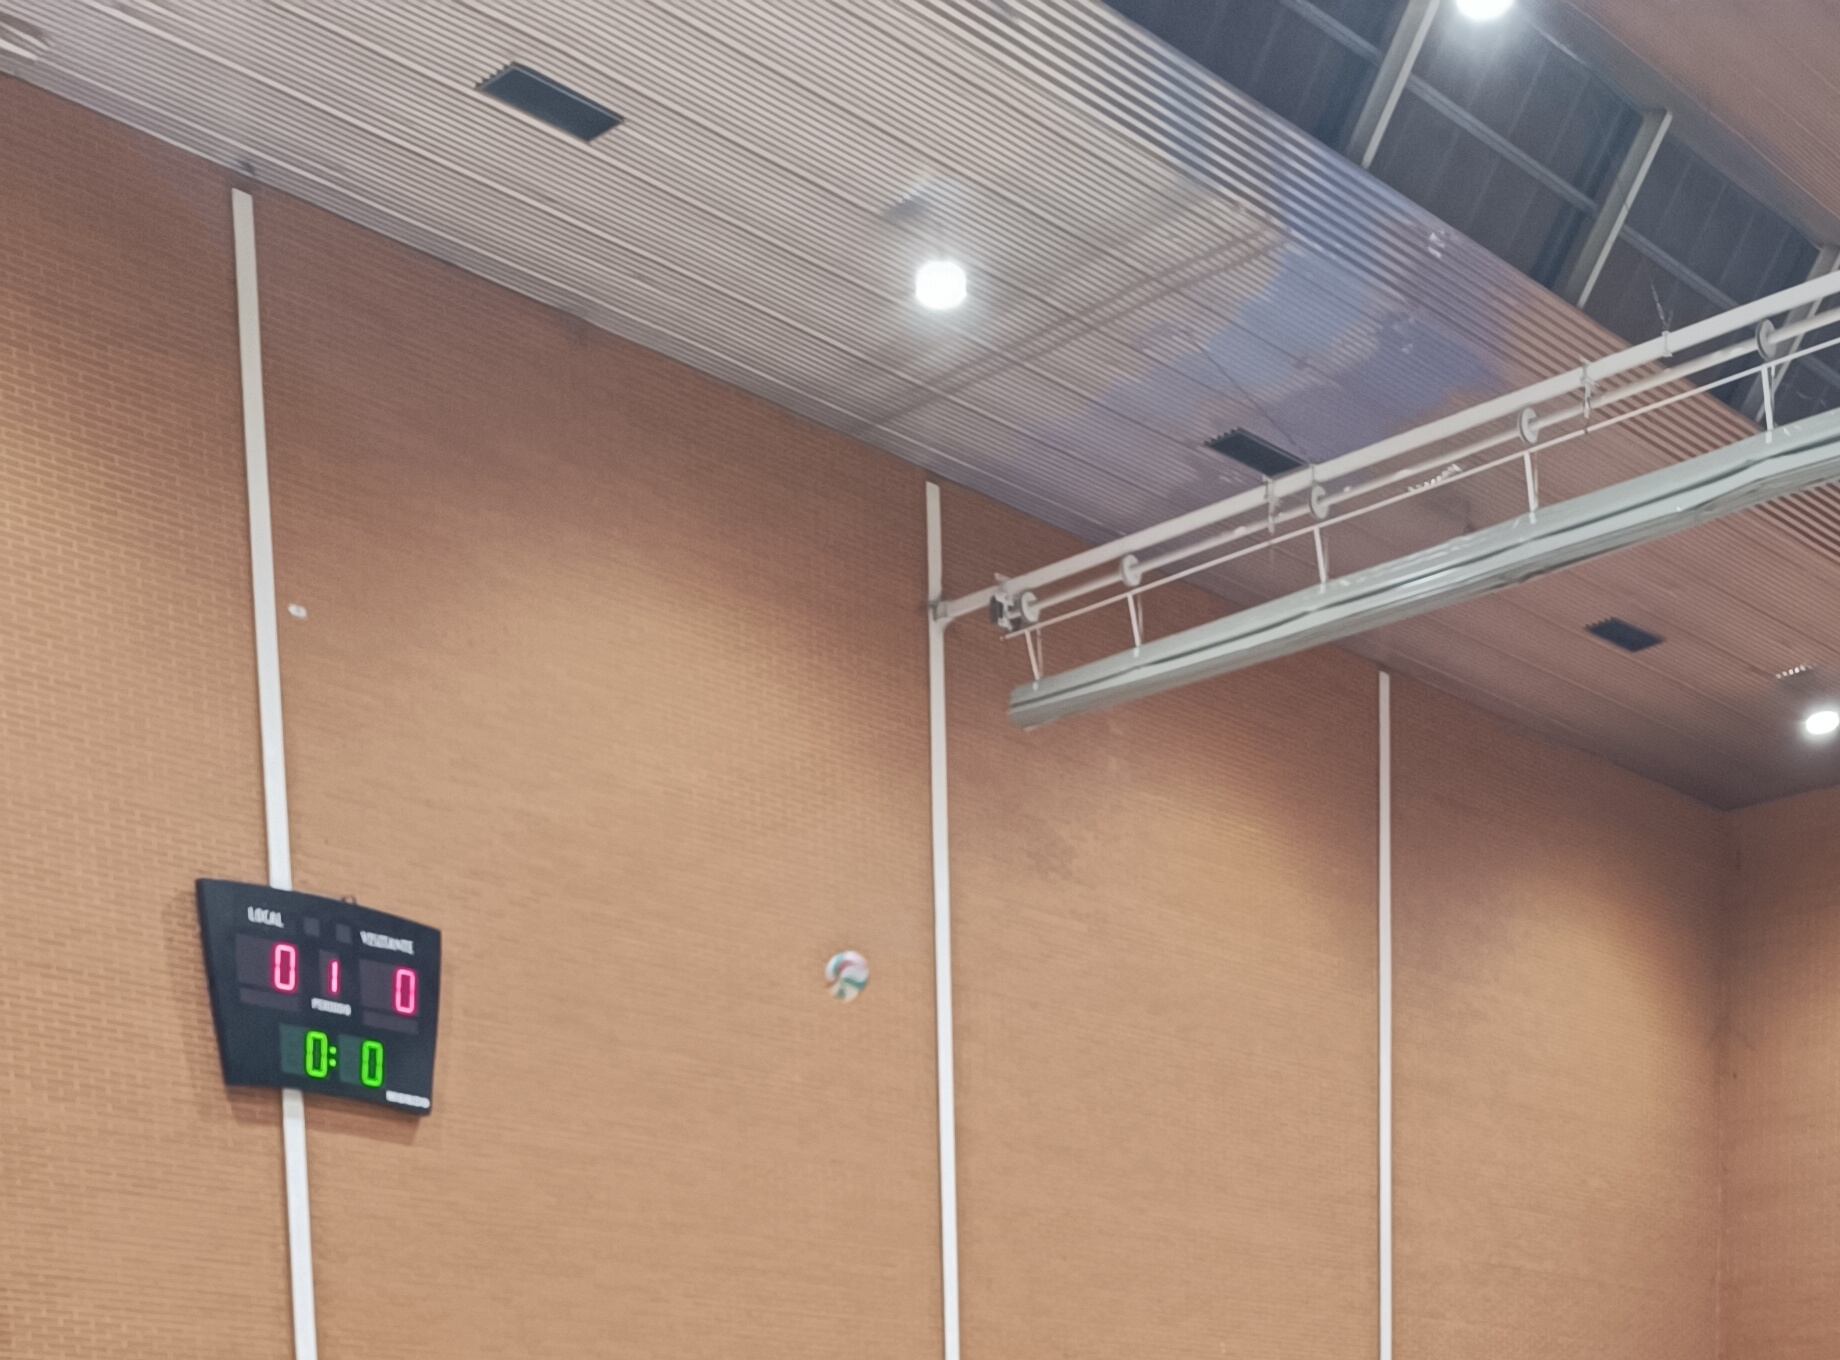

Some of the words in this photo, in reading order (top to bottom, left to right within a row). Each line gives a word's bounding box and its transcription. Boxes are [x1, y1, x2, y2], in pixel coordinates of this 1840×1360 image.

[247, 906, 284, 928] LOCAL
[273, 944, 296, 991] 0
[330, 960, 339, 993] 1
[395, 967, 416, 1014] 0
